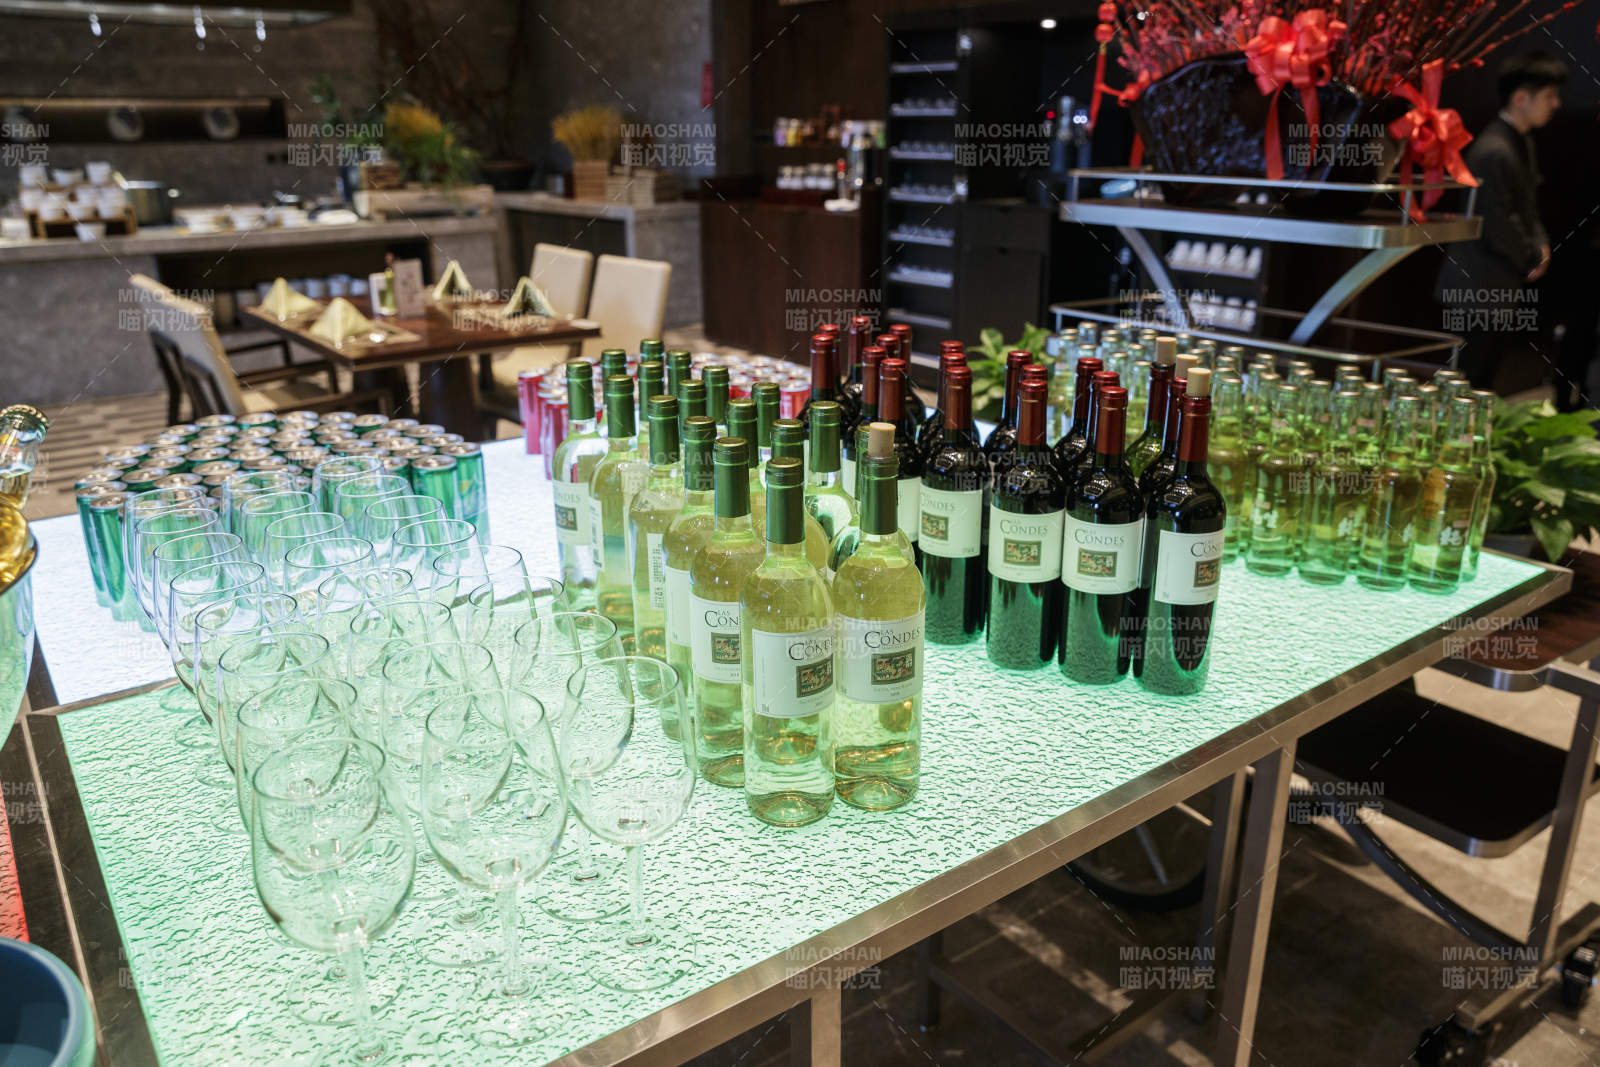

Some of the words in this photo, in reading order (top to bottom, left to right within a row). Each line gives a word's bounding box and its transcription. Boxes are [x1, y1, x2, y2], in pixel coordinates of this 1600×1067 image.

[1000, 519, 1048, 535] CONDES
[1075, 528, 1125, 545] CONDES
[865, 627, 921, 649] CONDES
